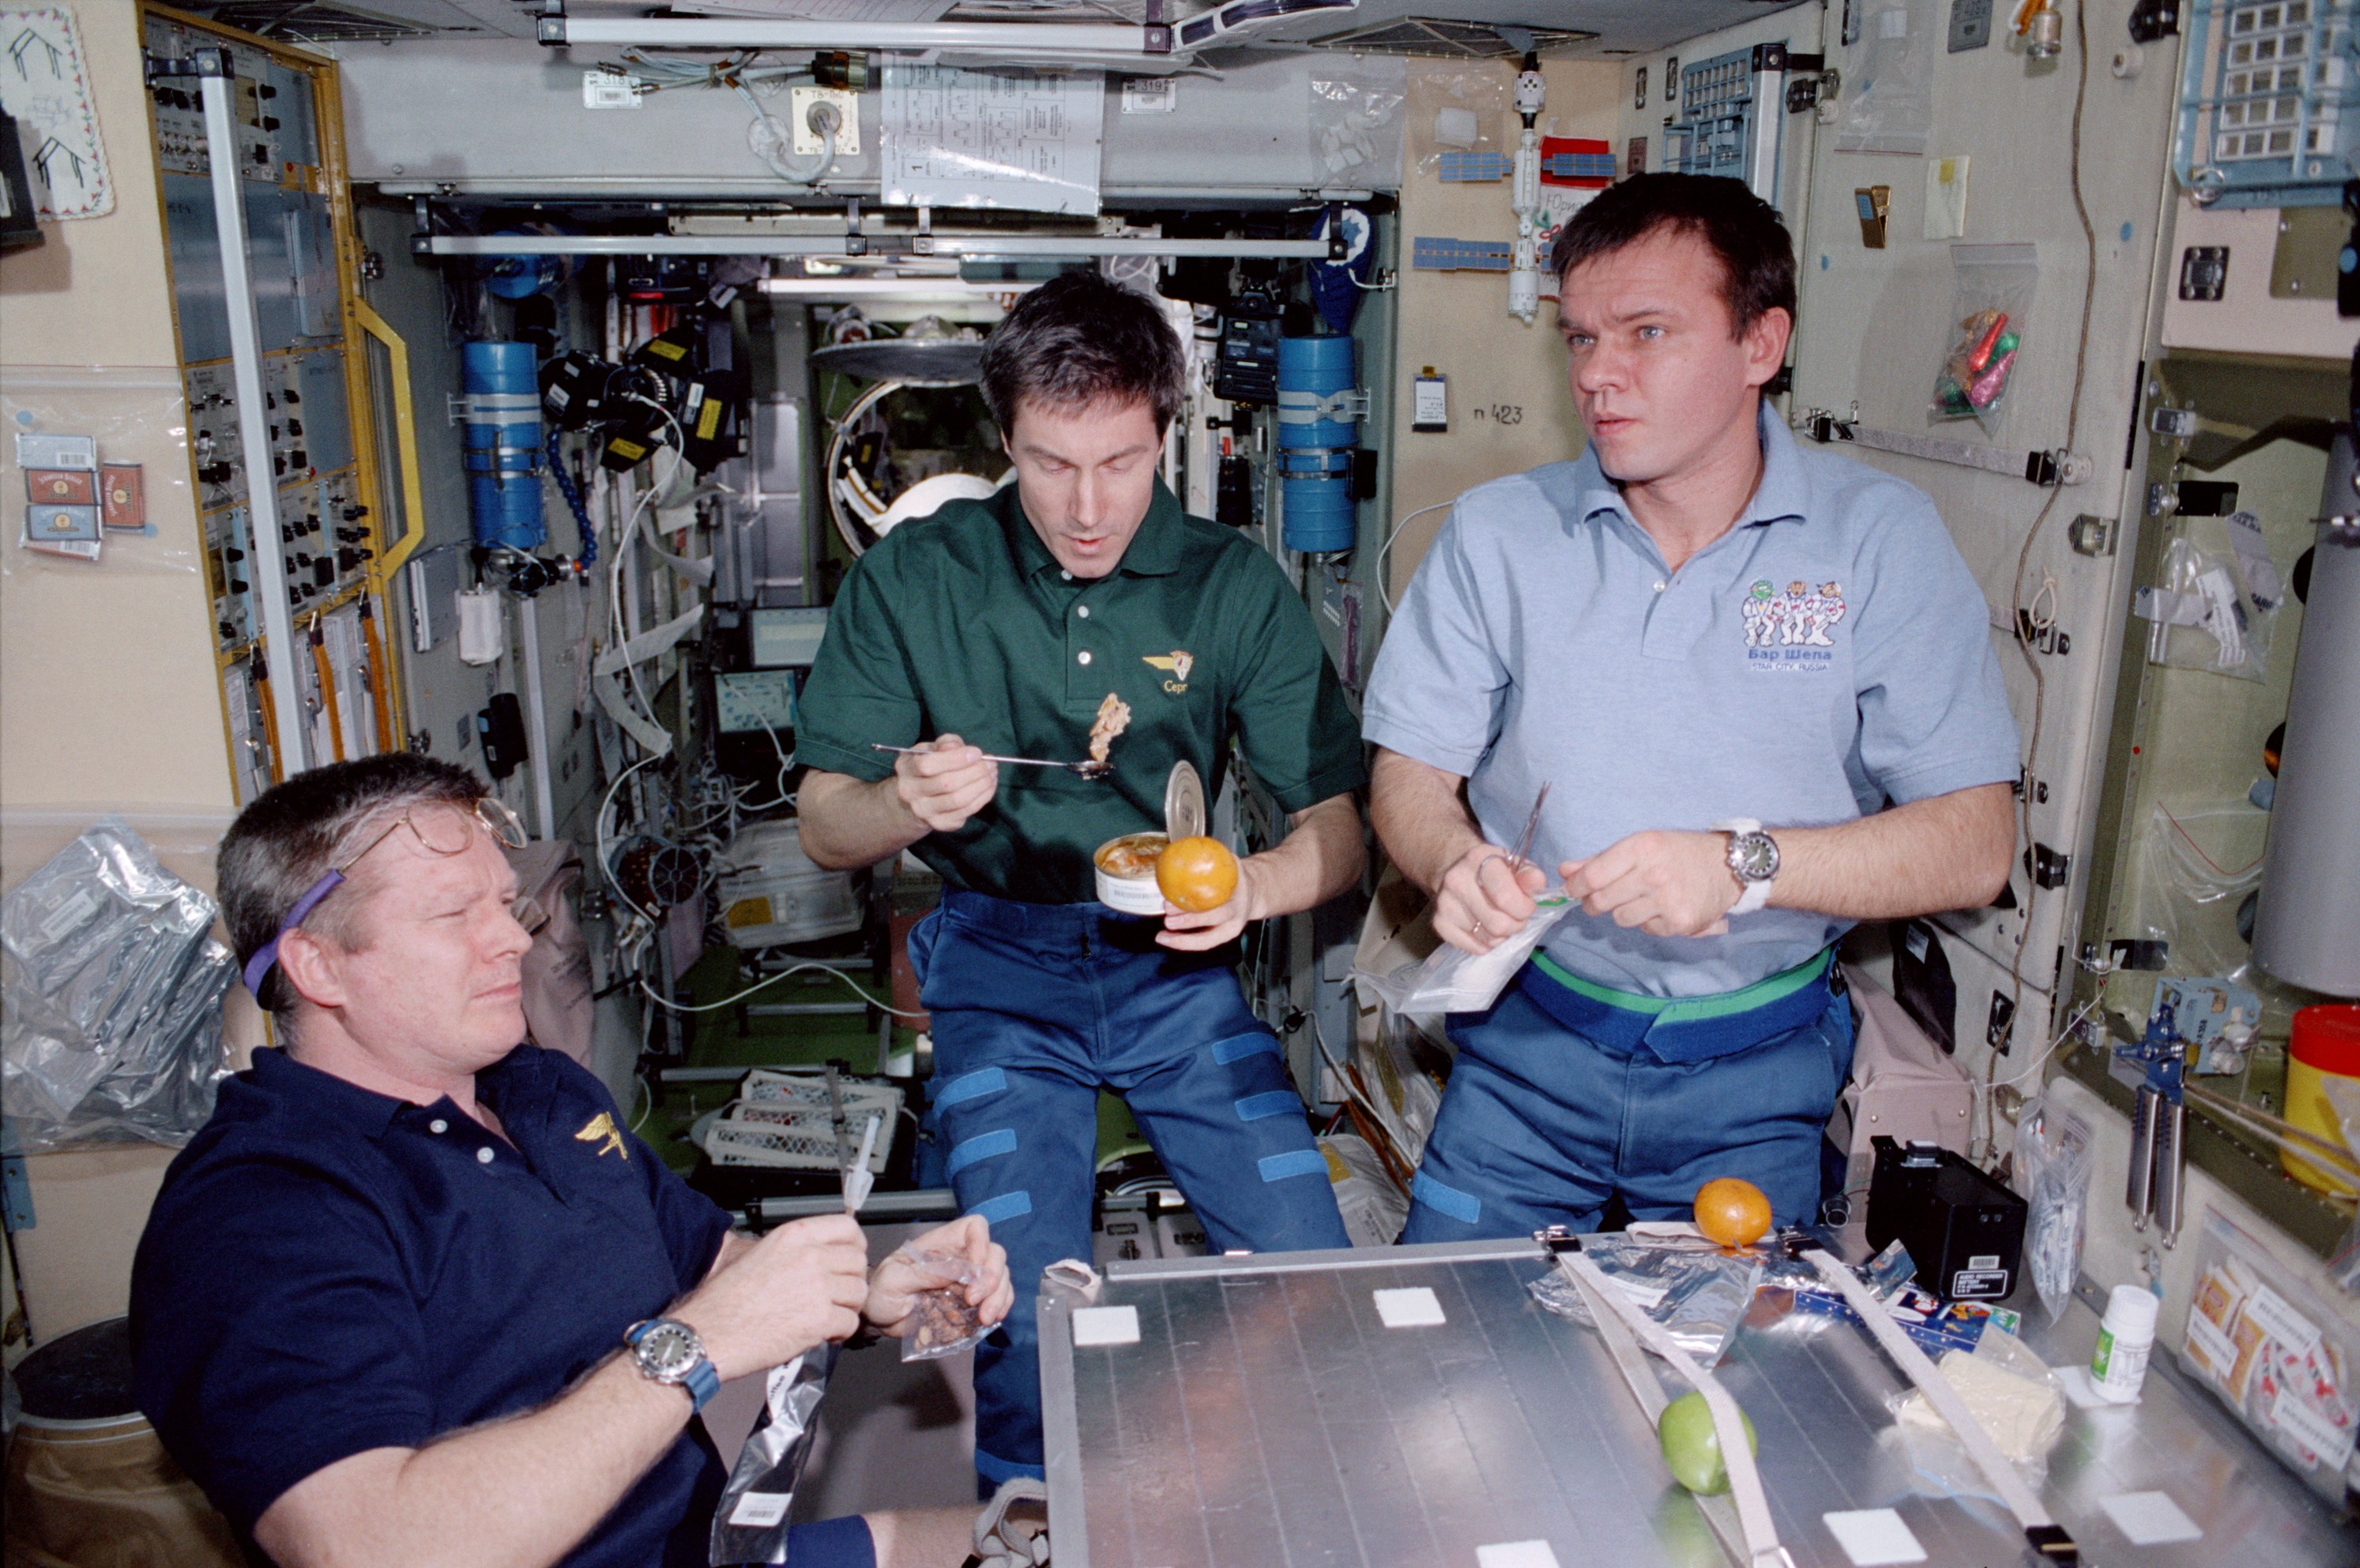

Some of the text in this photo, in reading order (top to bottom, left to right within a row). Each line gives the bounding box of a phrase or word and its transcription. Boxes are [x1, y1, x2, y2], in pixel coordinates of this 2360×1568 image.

[1141, 80, 1162, 91] 319
[1492, 404, 1522, 424] 423
[1749, 649, 1832, 662] Бар Шепа
[1798, 663, 1828, 672] RUSSIA
